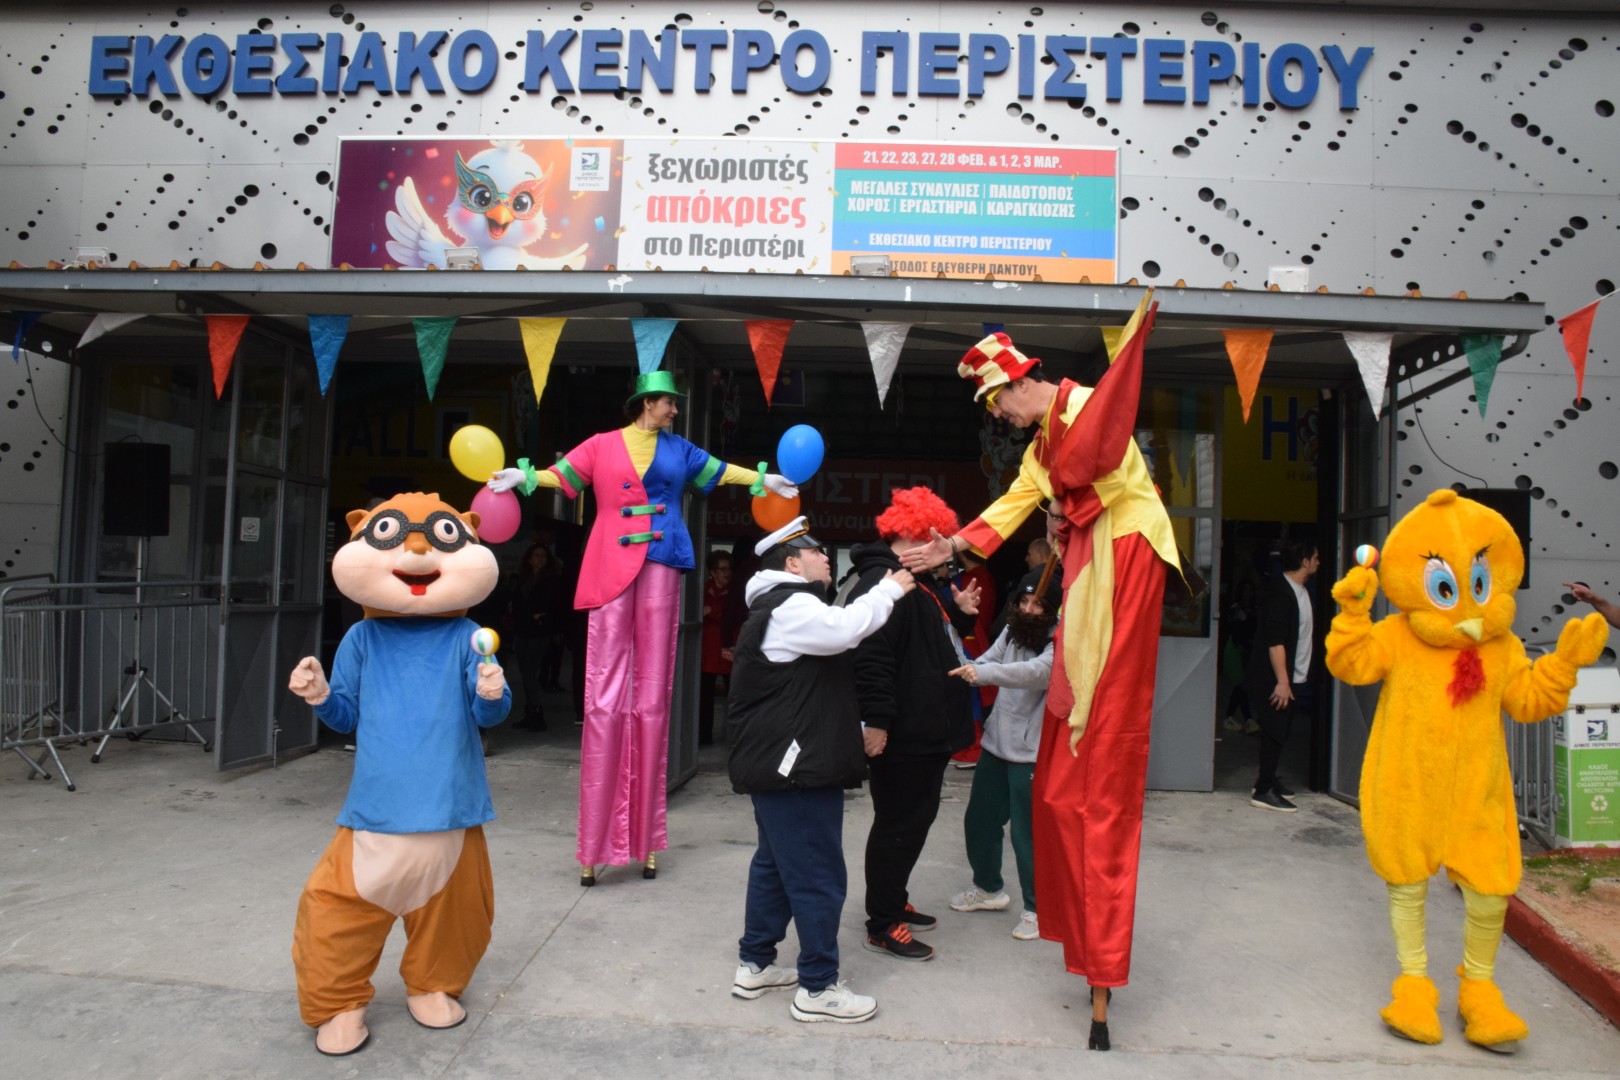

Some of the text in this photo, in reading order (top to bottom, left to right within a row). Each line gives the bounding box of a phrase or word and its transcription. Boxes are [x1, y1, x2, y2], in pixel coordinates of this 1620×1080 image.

[89, 29, 1374, 112] ΕΚΘΕΣΙΑΚΟ ΚΕΝΤΡΟ ΠΕΡΙΣΤΕΡΙΟΥ
[648, 153, 808, 184] ξεχωριστές
[863, 150, 1062, 169] 21, 22, 23, 27, 28 ΦΕΒ. & 1, 2, 3 ΜΑΡ.
[850, 180, 908, 196] ΜΕΓΑΛΕΣ
[911, 182, 979, 198] ΣΥΝΑΥΛΙΕΣ
[989, 184, 1073, 200] ΠΑΙΔΟΤΟΠΟΣ
[646, 189, 806, 228] απόκριες
[847, 197, 890, 213] ΧΟΡΟΣ
[900, 199, 977, 215] ΕΡΓΑΣΤΗΡΙΑ
[987, 201, 1075, 218] ΚΑΡΑΓΚΙΟΖΗΣ
[644, 233, 805, 260] στο Περιστέρι
[869, 233, 1053, 251] ΕΚΘΕΣΙΑΚΟ ΚΕΝΤΡΟ ΠΕΡΙΣΤΕΡΙΟΥ
[889, 260, 928, 272] ΙΣΟΔΟΣ
